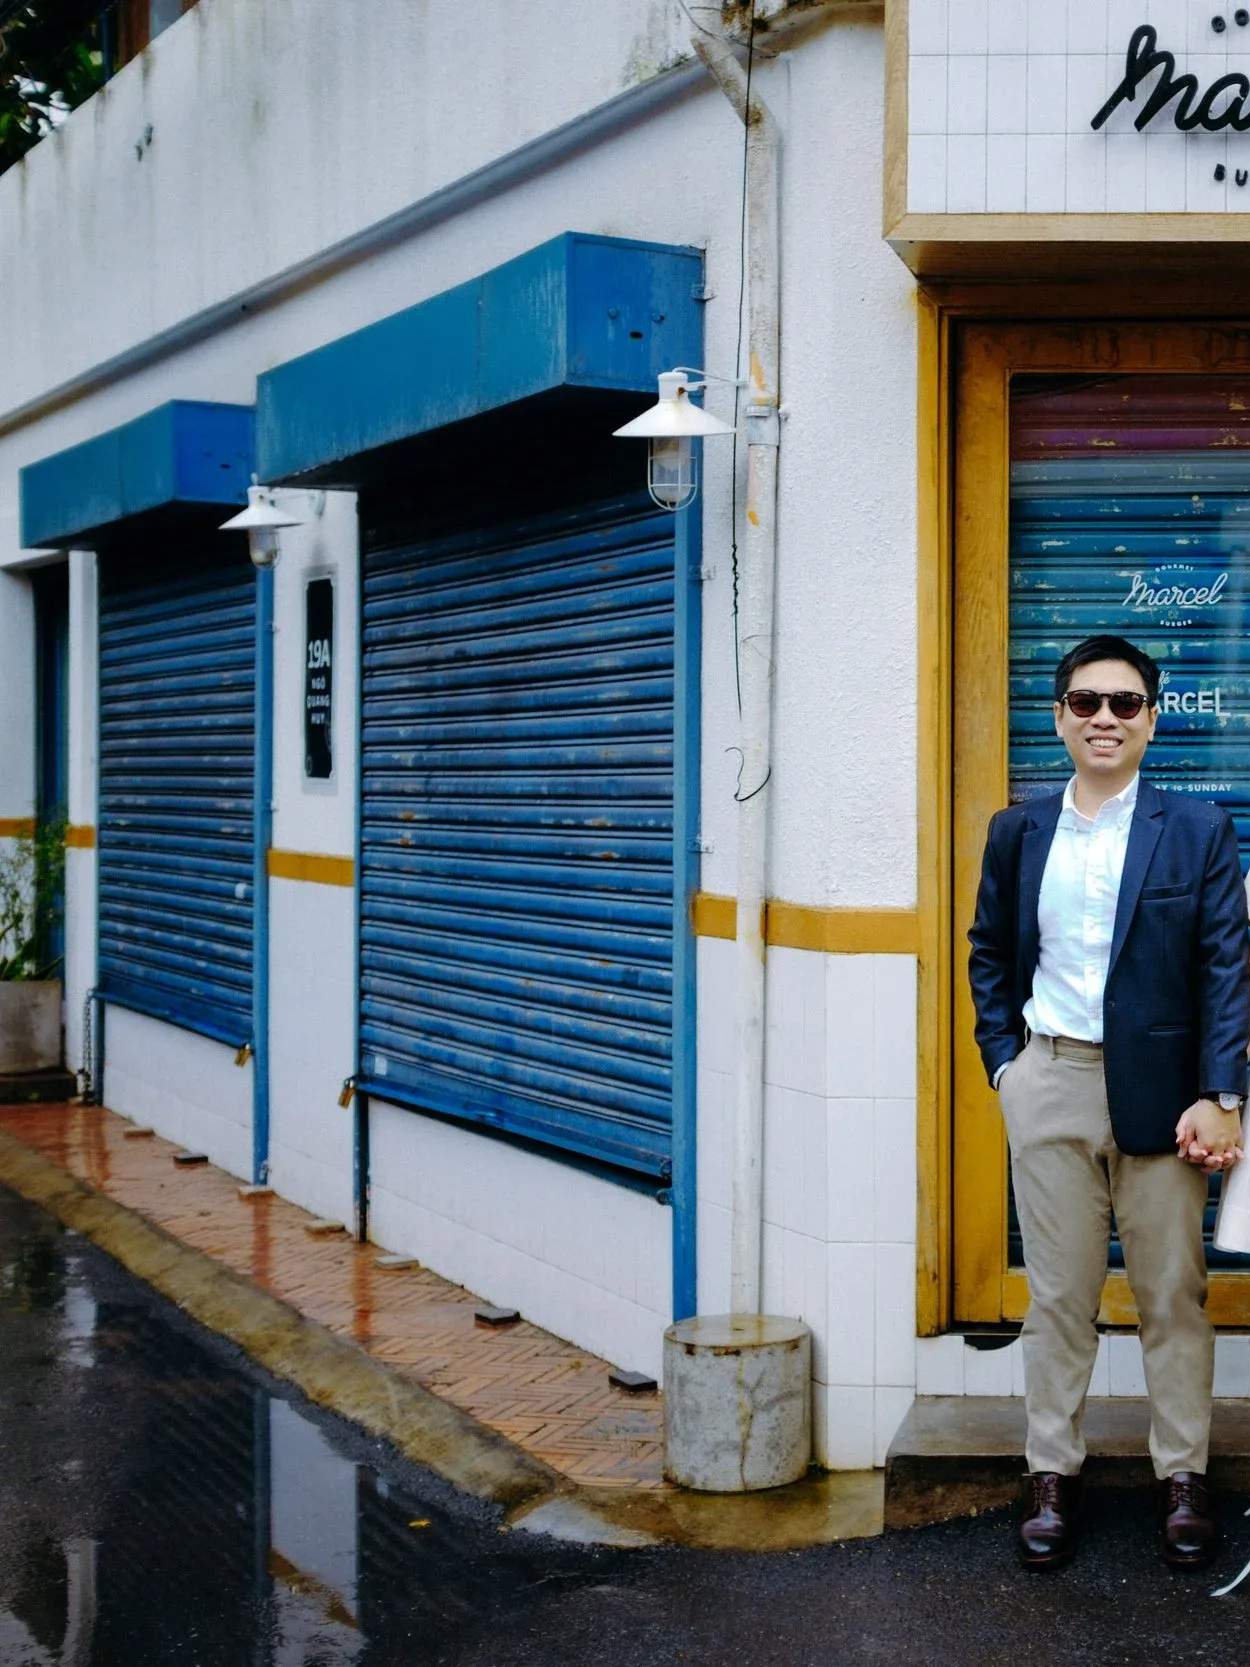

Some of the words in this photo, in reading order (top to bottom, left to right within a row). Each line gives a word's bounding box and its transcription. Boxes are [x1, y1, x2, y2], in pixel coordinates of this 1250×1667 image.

[1155, 564, 1194, 573] GOURMET
[1160, 619, 1193, 627] BURGER
[308, 639, 330, 669] 19A
[1187, 783, 1232, 792] SUNDAY
